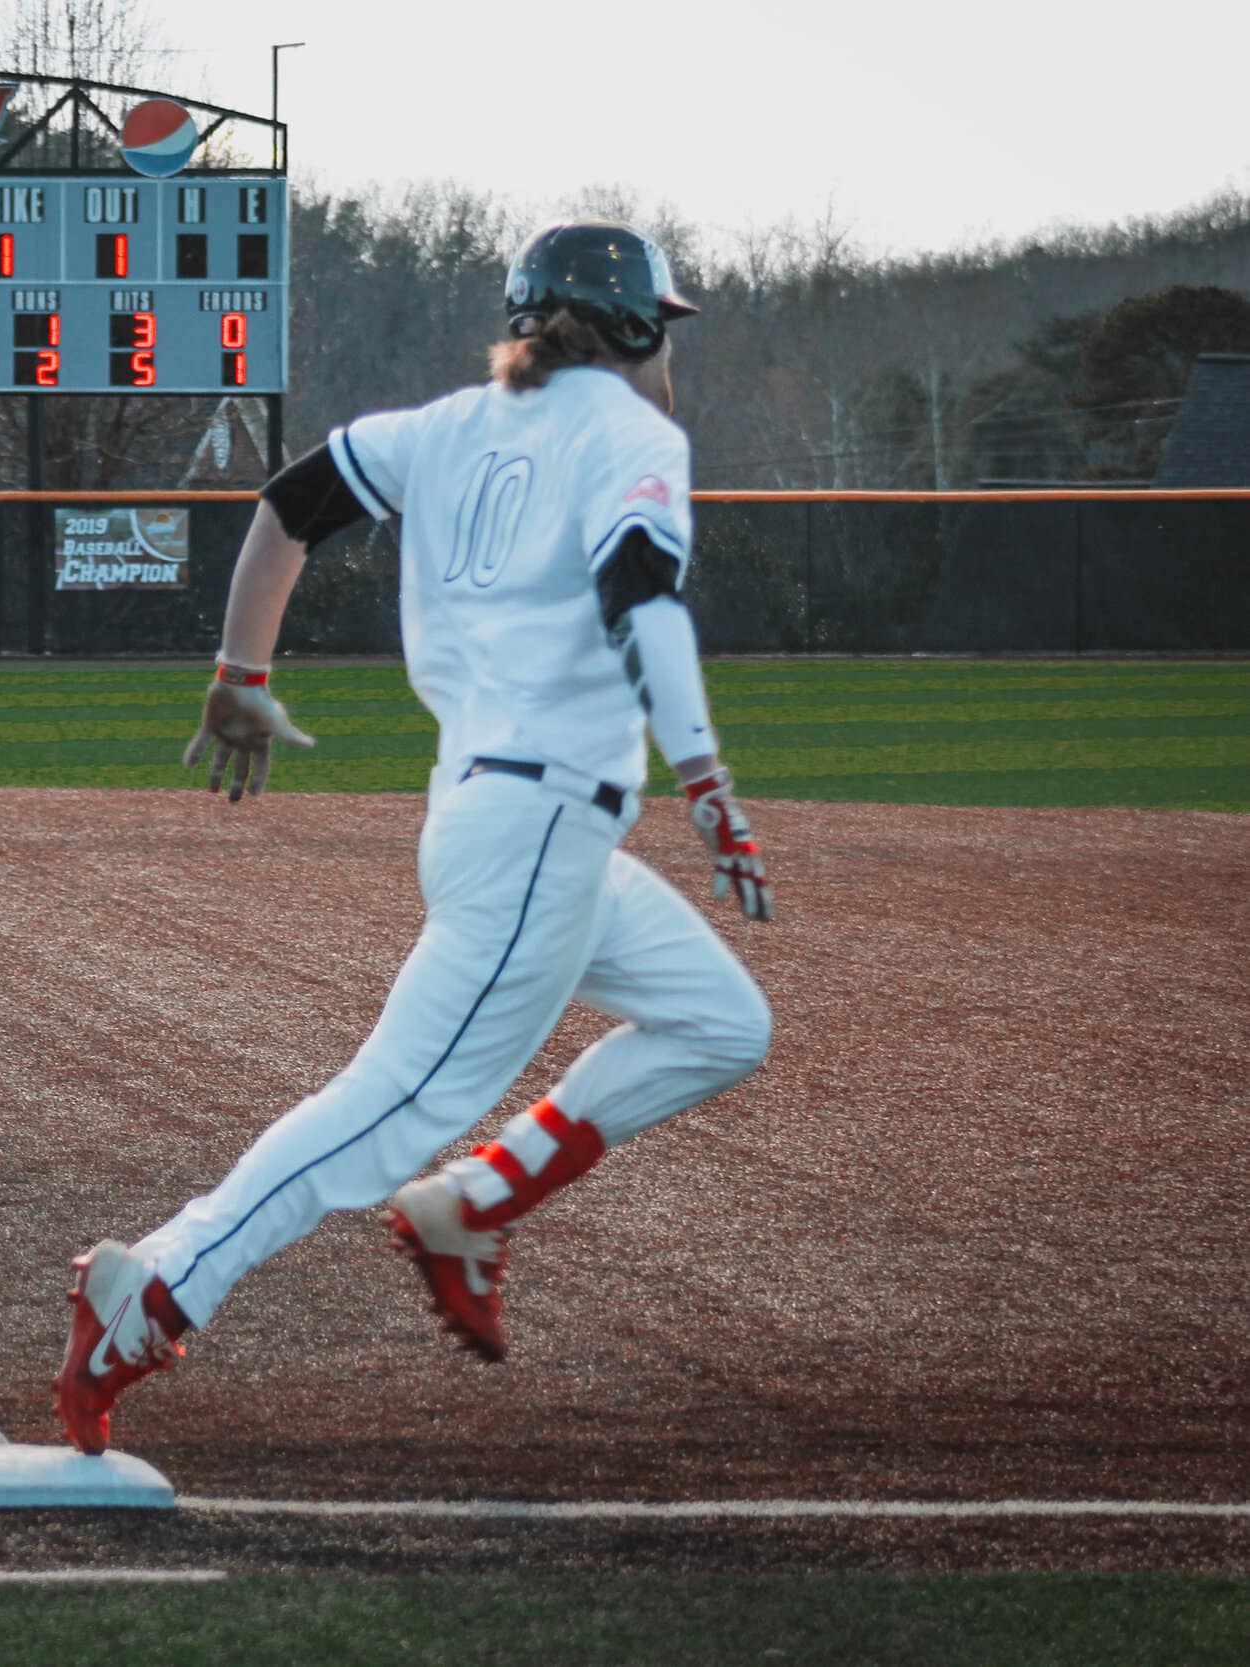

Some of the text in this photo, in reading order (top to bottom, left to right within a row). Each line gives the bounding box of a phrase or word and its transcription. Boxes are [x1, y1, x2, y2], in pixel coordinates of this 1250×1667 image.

[86, 188, 136, 222] OUT
[184, 189, 200, 222] H
[248, 189, 259, 222] E
[1, 234, 14, 277] 1
[115, 234, 128, 277] 1
[49, 314, 60, 346] 1
[133, 312, 156, 348] 3
[222, 313, 247, 348] 0
[36, 350, 60, 385] 2
[131, 351, 156, 386] 5
[235, 351, 246, 385] 1
[65, 517, 107, 536] 2019
[444, 450, 534, 588] 10
[61, 560, 179, 584] CHAMPION
